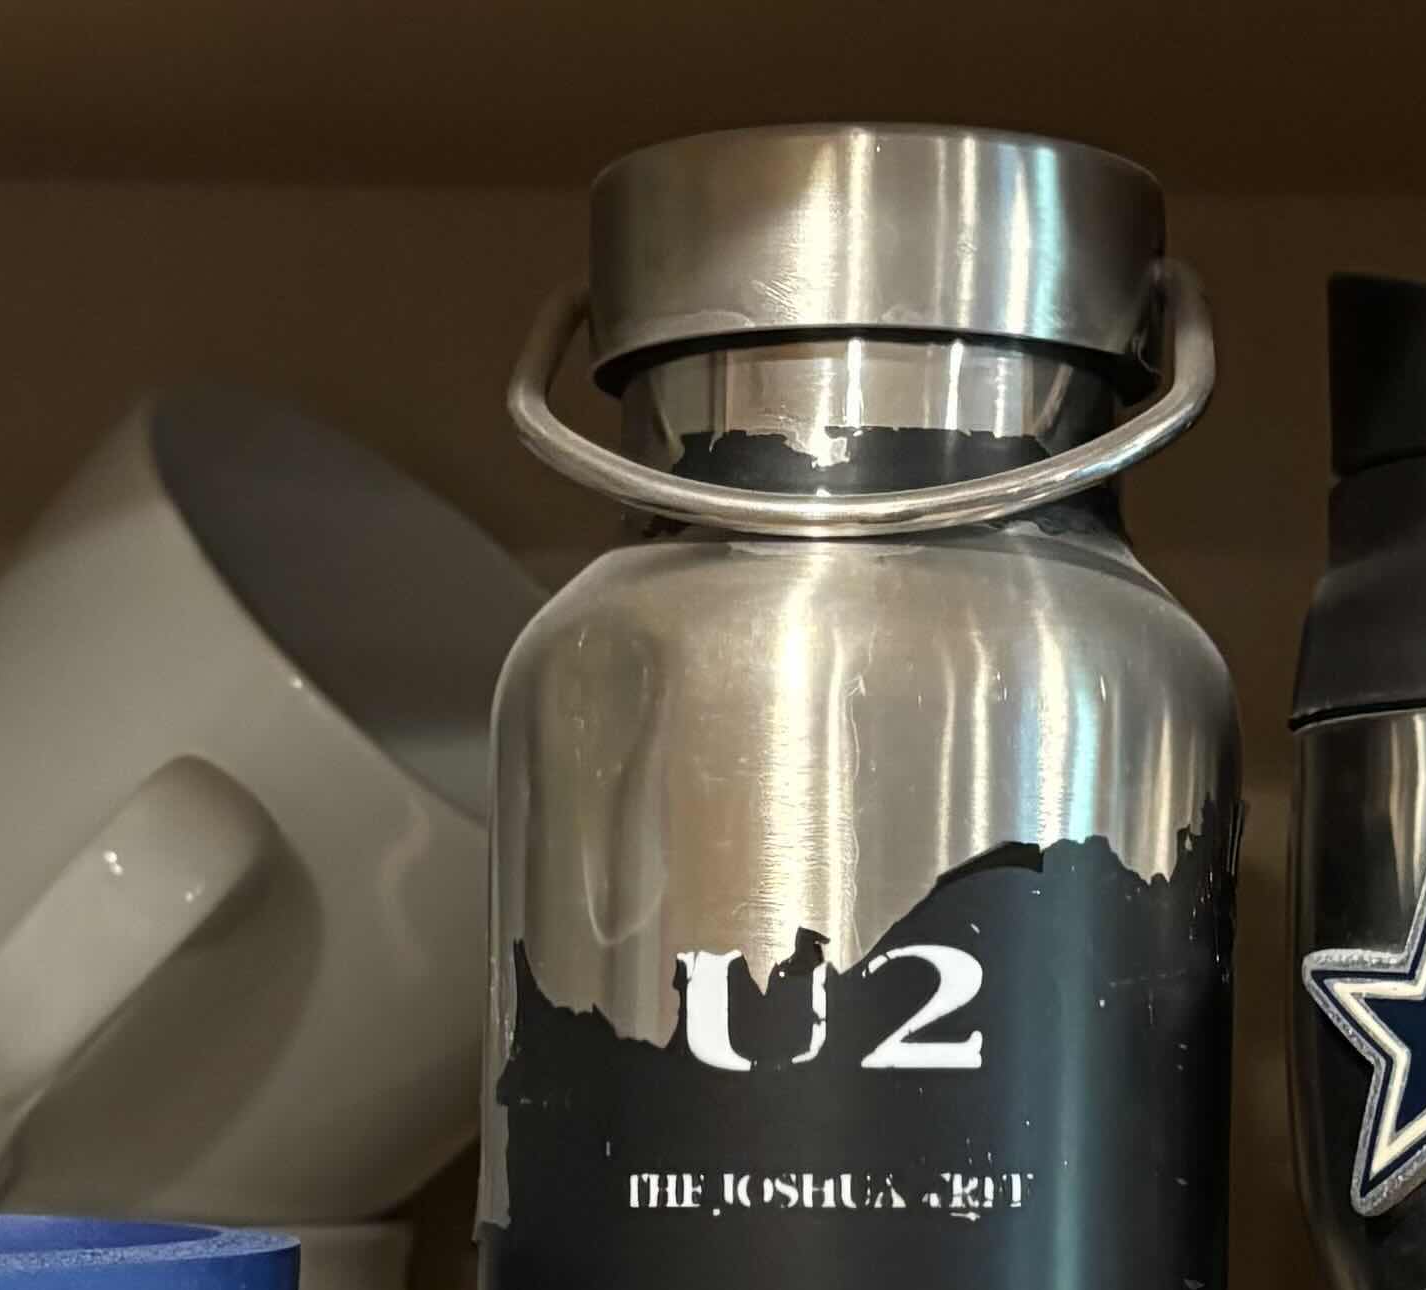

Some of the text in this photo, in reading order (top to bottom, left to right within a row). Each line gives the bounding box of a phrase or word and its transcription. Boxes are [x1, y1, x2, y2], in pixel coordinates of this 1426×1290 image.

[676, 944, 984, 1072] U2
[629, 1172, 704, 1208] THE
[722, 1172, 908, 1209] JOSHUA
